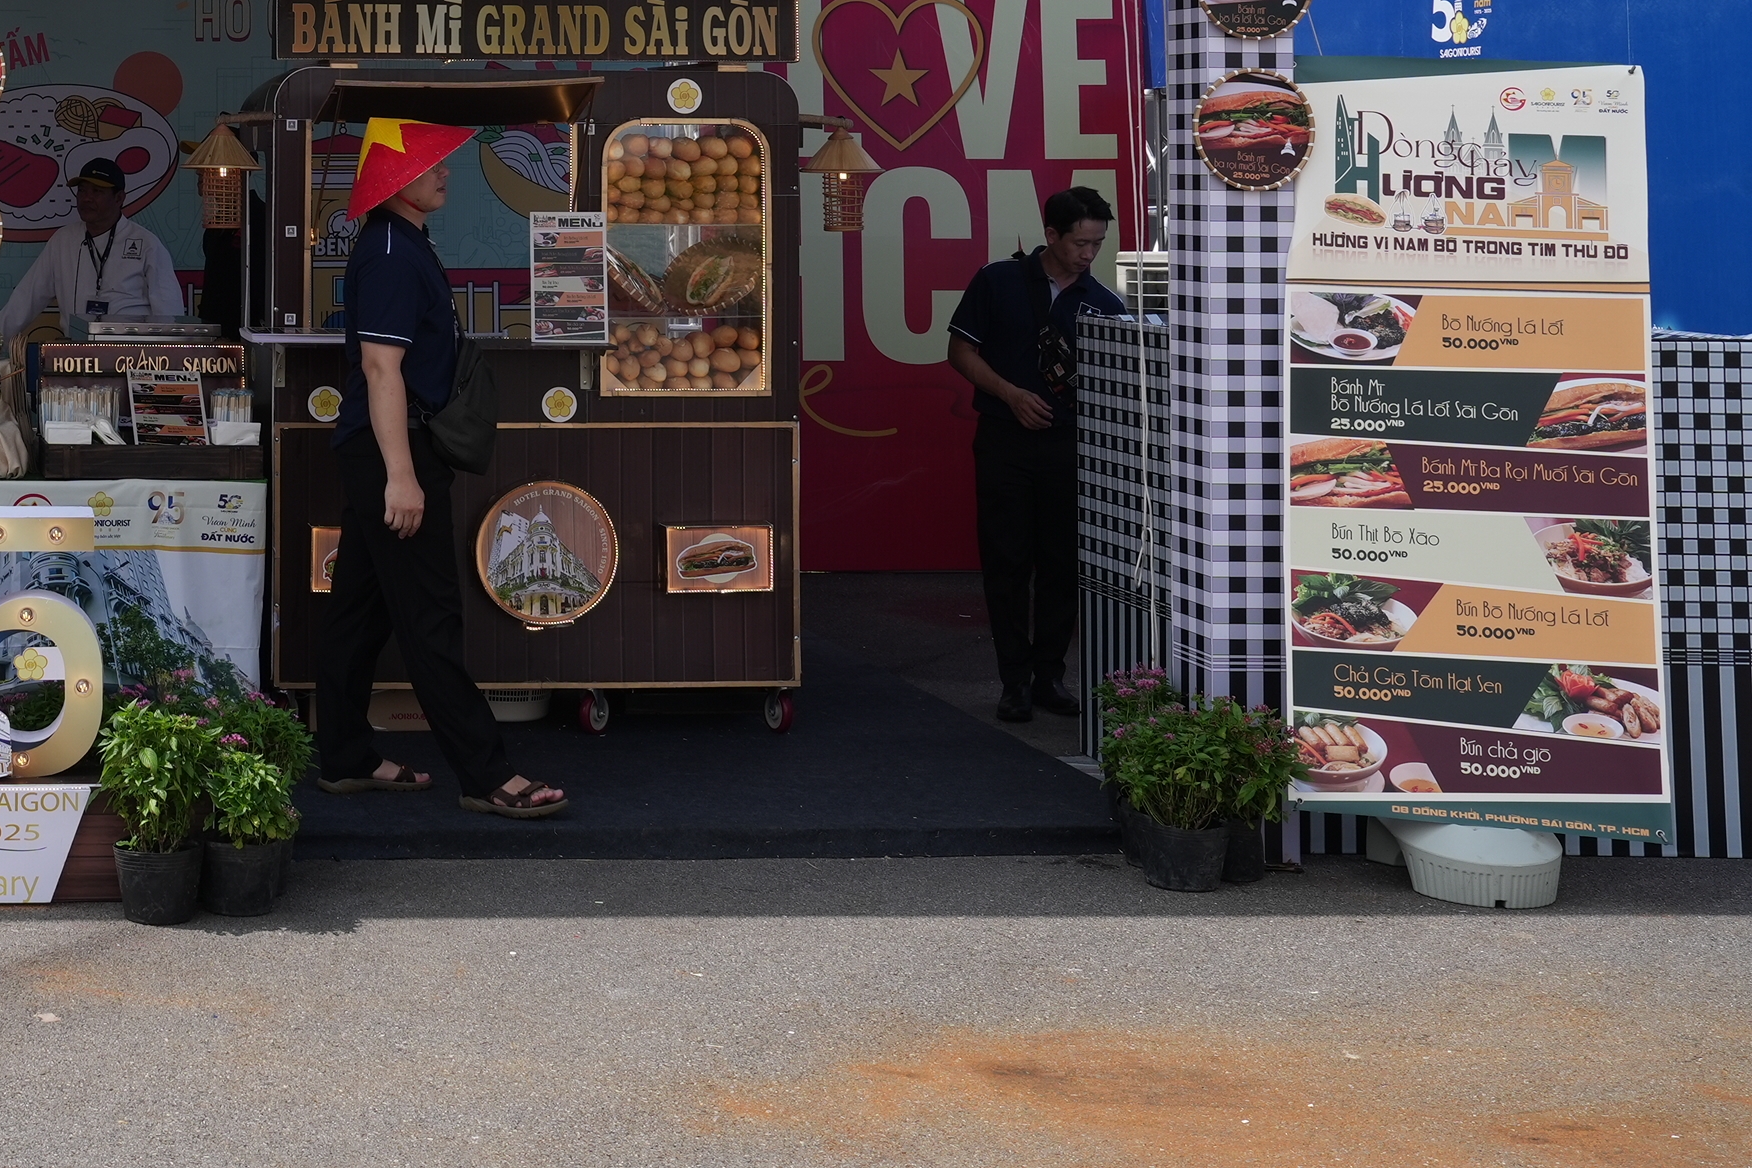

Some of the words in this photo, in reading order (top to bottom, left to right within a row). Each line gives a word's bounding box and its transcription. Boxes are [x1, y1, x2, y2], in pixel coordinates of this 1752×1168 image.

[1238, 4, 1255, 14] Bánh
[476, 3, 611, 56] GRAND
[1237, 151, 1255, 161] Bánh
[1356, 110, 1458, 168] Dòng
[1457, 142, 1538, 186] Chảy
[1312, 231, 1368, 250] HƯƠNG
[1373, 236, 1389, 252] VỊ
[1393, 236, 1429, 253] NAM
[1434, 236, 1458, 256] BỘ
[1462, 239, 1523, 256] TRONG
[1528, 242, 1557, 257] TIM
[1561, 239, 1598, 259] THỦ
[1466, 315, 1513, 336] Nướng
[1517, 317, 1537, 335] Lá
[1541, 318, 1565, 337] Lốt
[53, 357, 104, 374] HOTEL
[115, 349, 169, 373] GRAND
[183, 357, 238, 374] SAIGON
[1331, 376, 1363, 395] Bánh
[1354, 395, 1400, 418] Nướng
[1404, 398, 1424, 416] Lá
[1428, 399, 1450, 418] Lốt
[1422, 456, 1455, 475] Bánh
[1480, 459, 1500, 478] Ba
[1505, 461, 1528, 481] Rọi
[1533, 463, 1569, 482] Muối
[513, 490, 540, 506] HOTEL
[543, 489, 572, 500] GRAND
[574, 496, 599, 521] SAIGON
[201, 532, 223, 543] ĐẤT
[225, 533, 255, 544] NƯỚC
[599, 528, 607, 553] SINCE
[1332, 523, 1353, 540] Bún
[1358, 524, 1379, 545] Thịt
[597, 555, 607, 575] 1930
[1456, 599, 1478, 617] Bún
[1508, 603, 1556, 627] Nướng
[1560, 606, 1580, 624] Lá
[1585, 608, 1610, 628] Lốt
[1333, 663, 1369, 683] Chả
[1447, 672, 1472, 694] Hạt
[1476, 674, 1503, 694] Sen
[1460, 737, 1482, 758] Bún
[1487, 741, 1518, 760] chả
[1413, 806, 1448, 817] ĐỒNG
[1598, 824, 1620, 834] TP.
[1622, 826, 1650, 837] HCM
